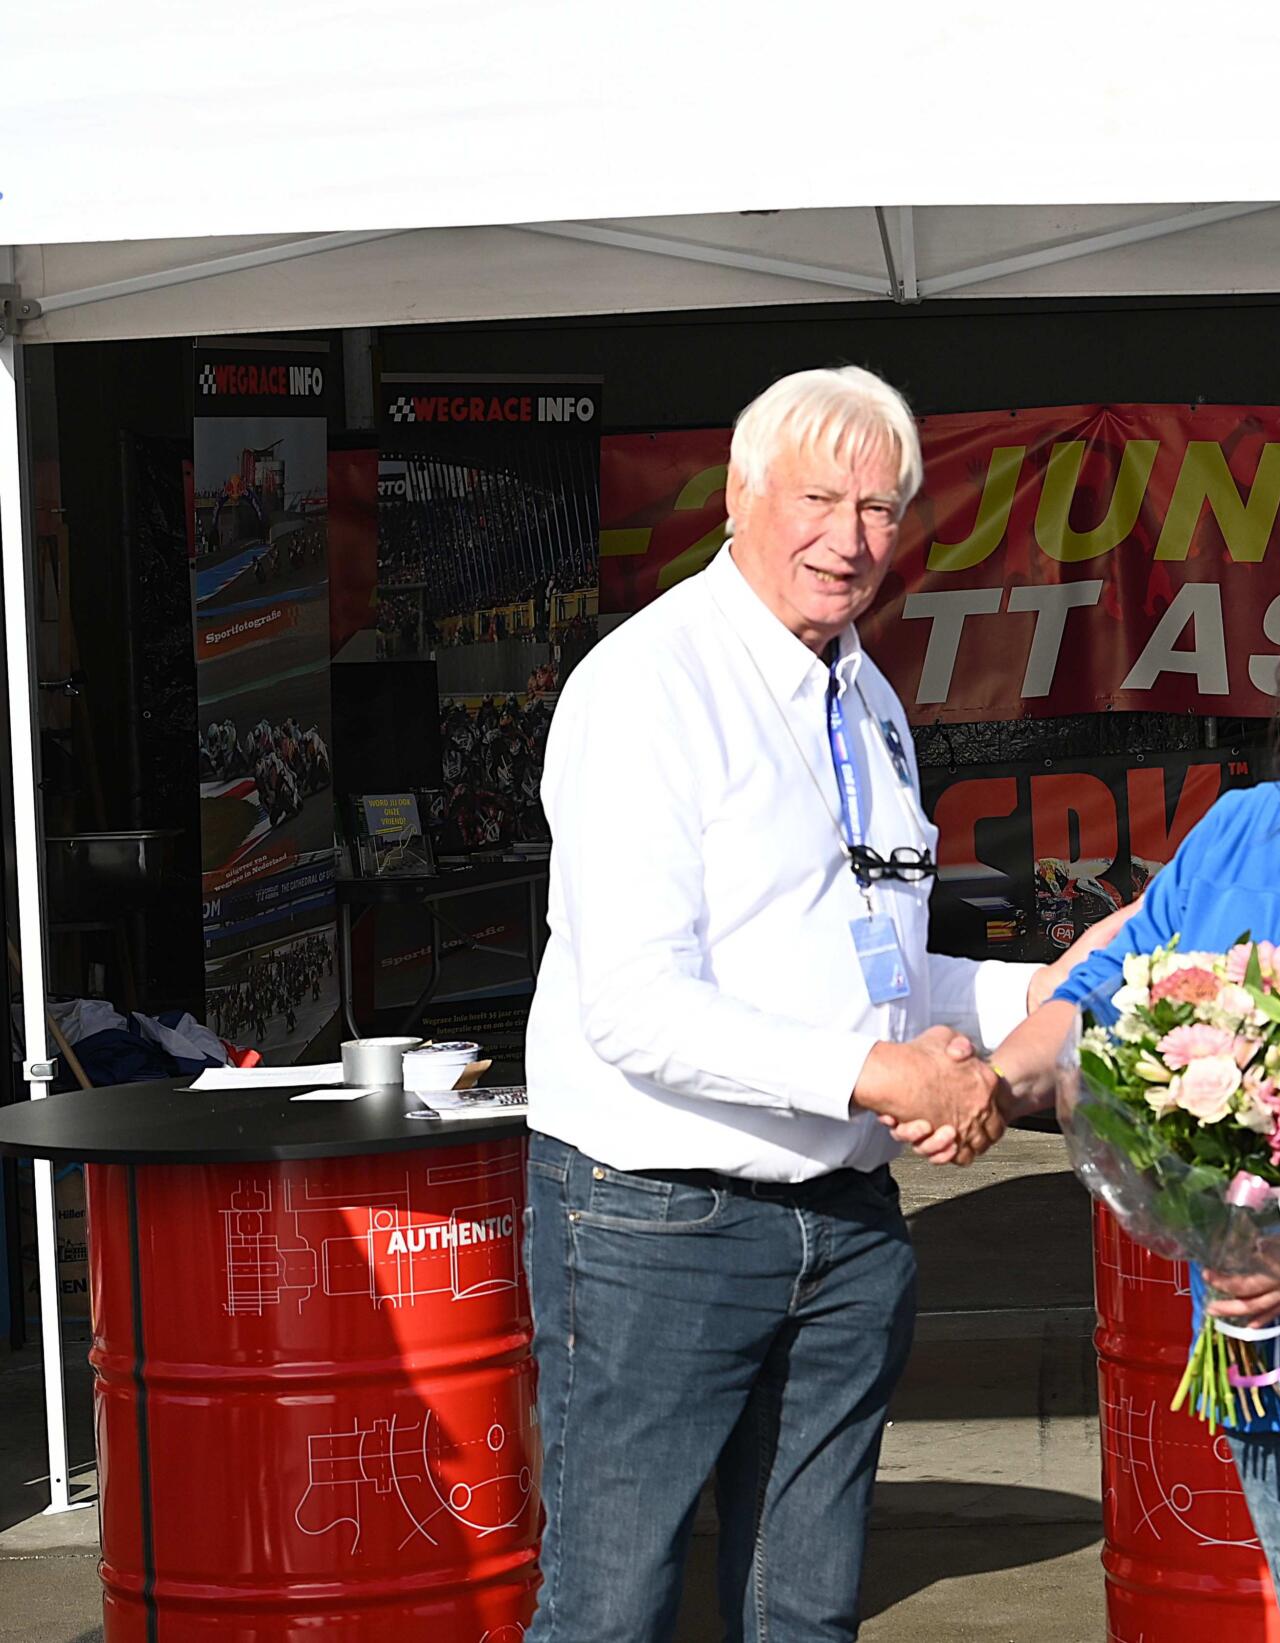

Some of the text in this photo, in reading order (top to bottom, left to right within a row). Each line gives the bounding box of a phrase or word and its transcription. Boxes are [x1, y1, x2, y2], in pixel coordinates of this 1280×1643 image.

[215, 366, 323, 396] WEGRACE INFO
[414, 396, 596, 423] WEGRACE INFO
[902, 580, 1103, 704] TT
[386, 1213, 514, 1256] AUTHENTIC
